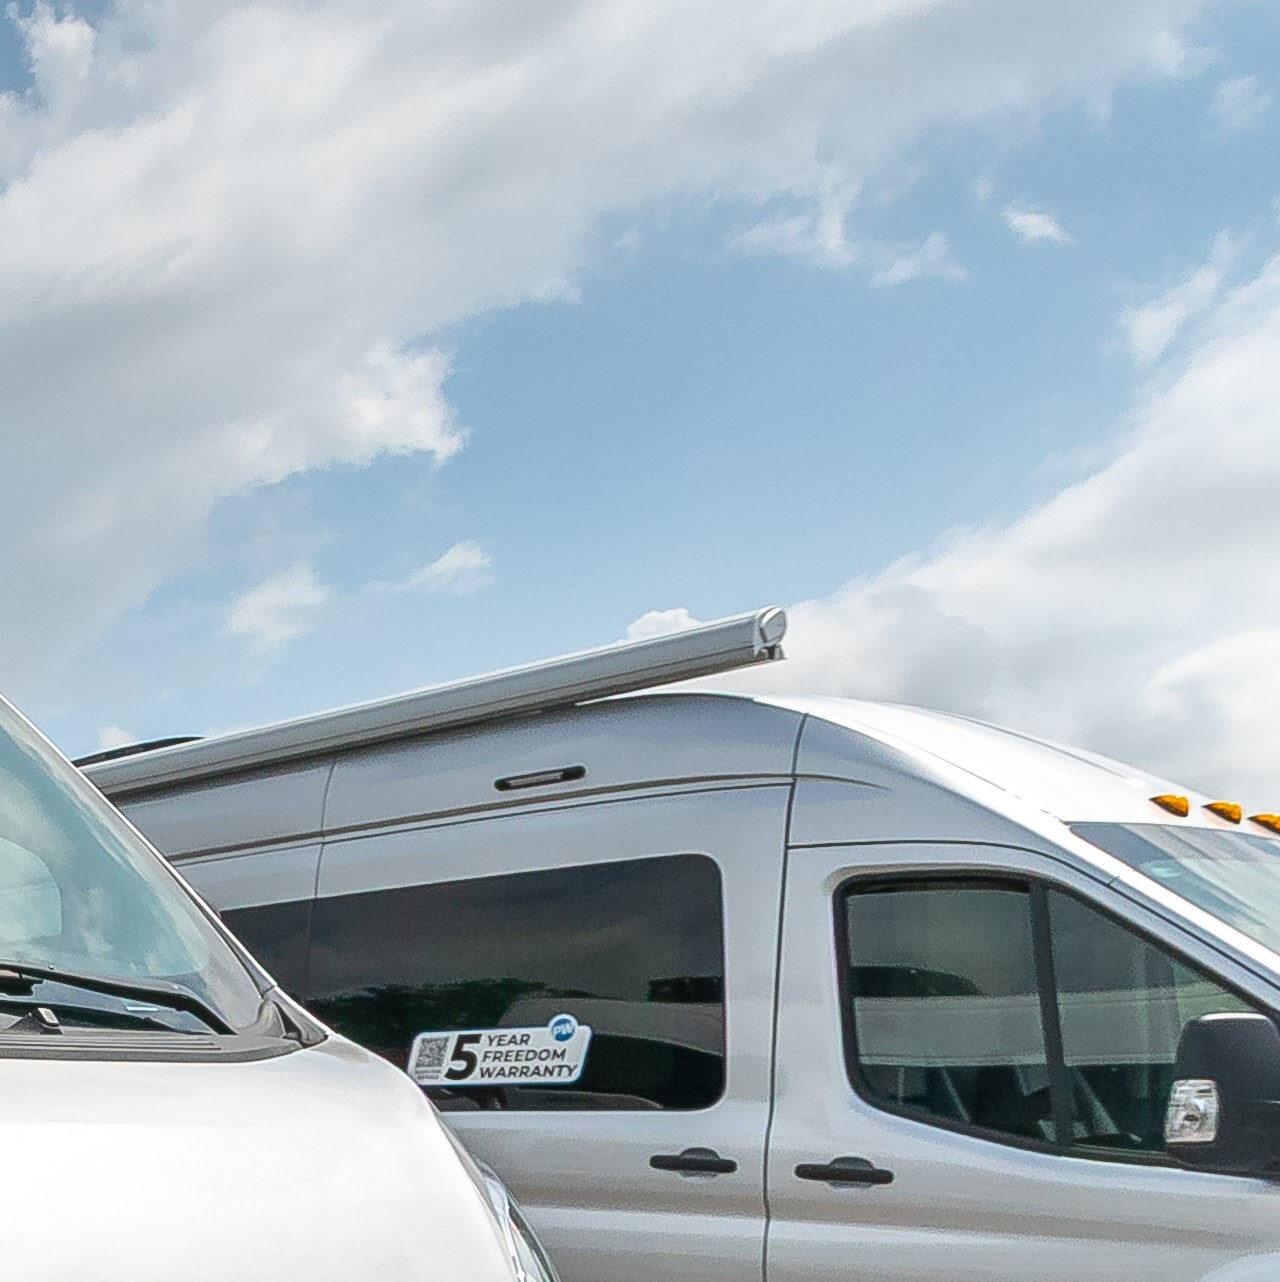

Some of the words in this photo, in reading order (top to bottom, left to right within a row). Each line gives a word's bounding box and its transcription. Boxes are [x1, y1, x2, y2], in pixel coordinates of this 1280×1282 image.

[488, 1034, 530, 1046] YEAR
[444, 1034, 482, 1080] 5
[483, 1049, 566, 1062] FREEDOM
[480, 1065, 578, 1078] WARRANTY
